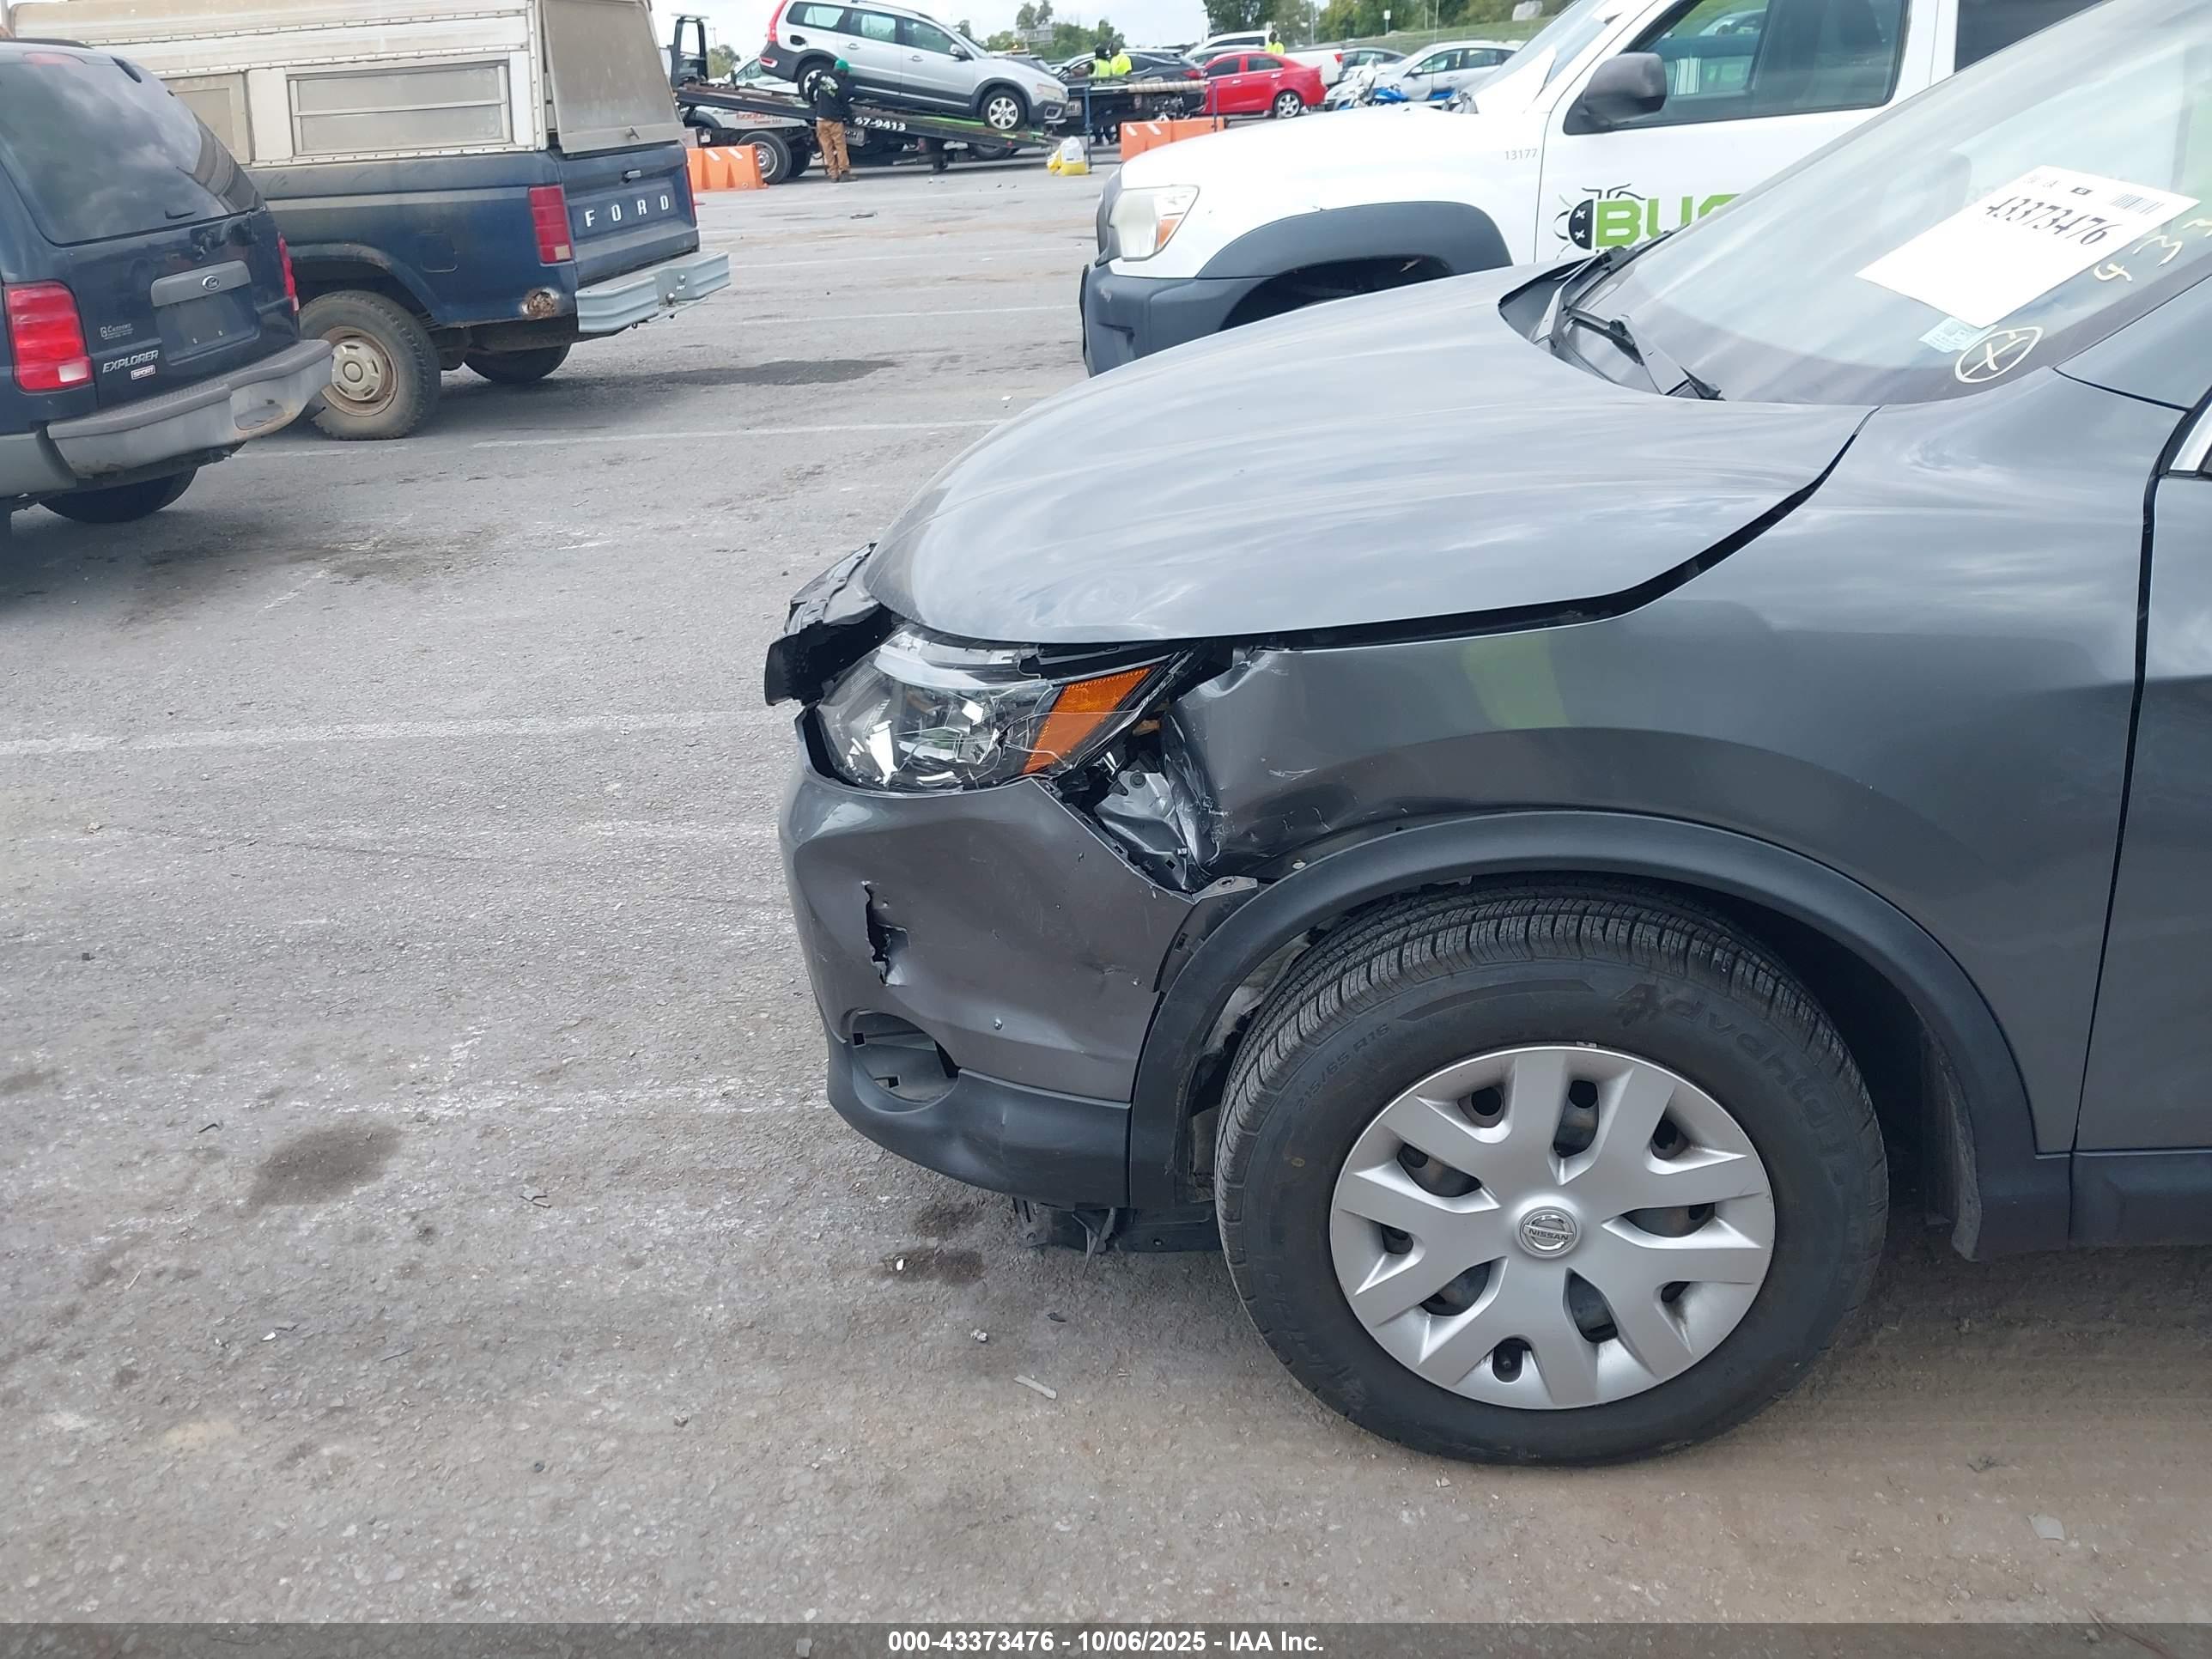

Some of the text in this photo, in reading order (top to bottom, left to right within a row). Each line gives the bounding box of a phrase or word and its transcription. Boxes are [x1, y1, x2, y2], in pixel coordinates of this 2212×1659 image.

[1504, 148, 1538, 161] 13177
[584, 195, 670, 228] FORD
[1985, 196, 2123, 246] 43373476
[103, 350, 158, 374] EXPLORER
[132, 366, 155, 378] SPORT
[1528, 1229, 1569, 1241] NISSAN
